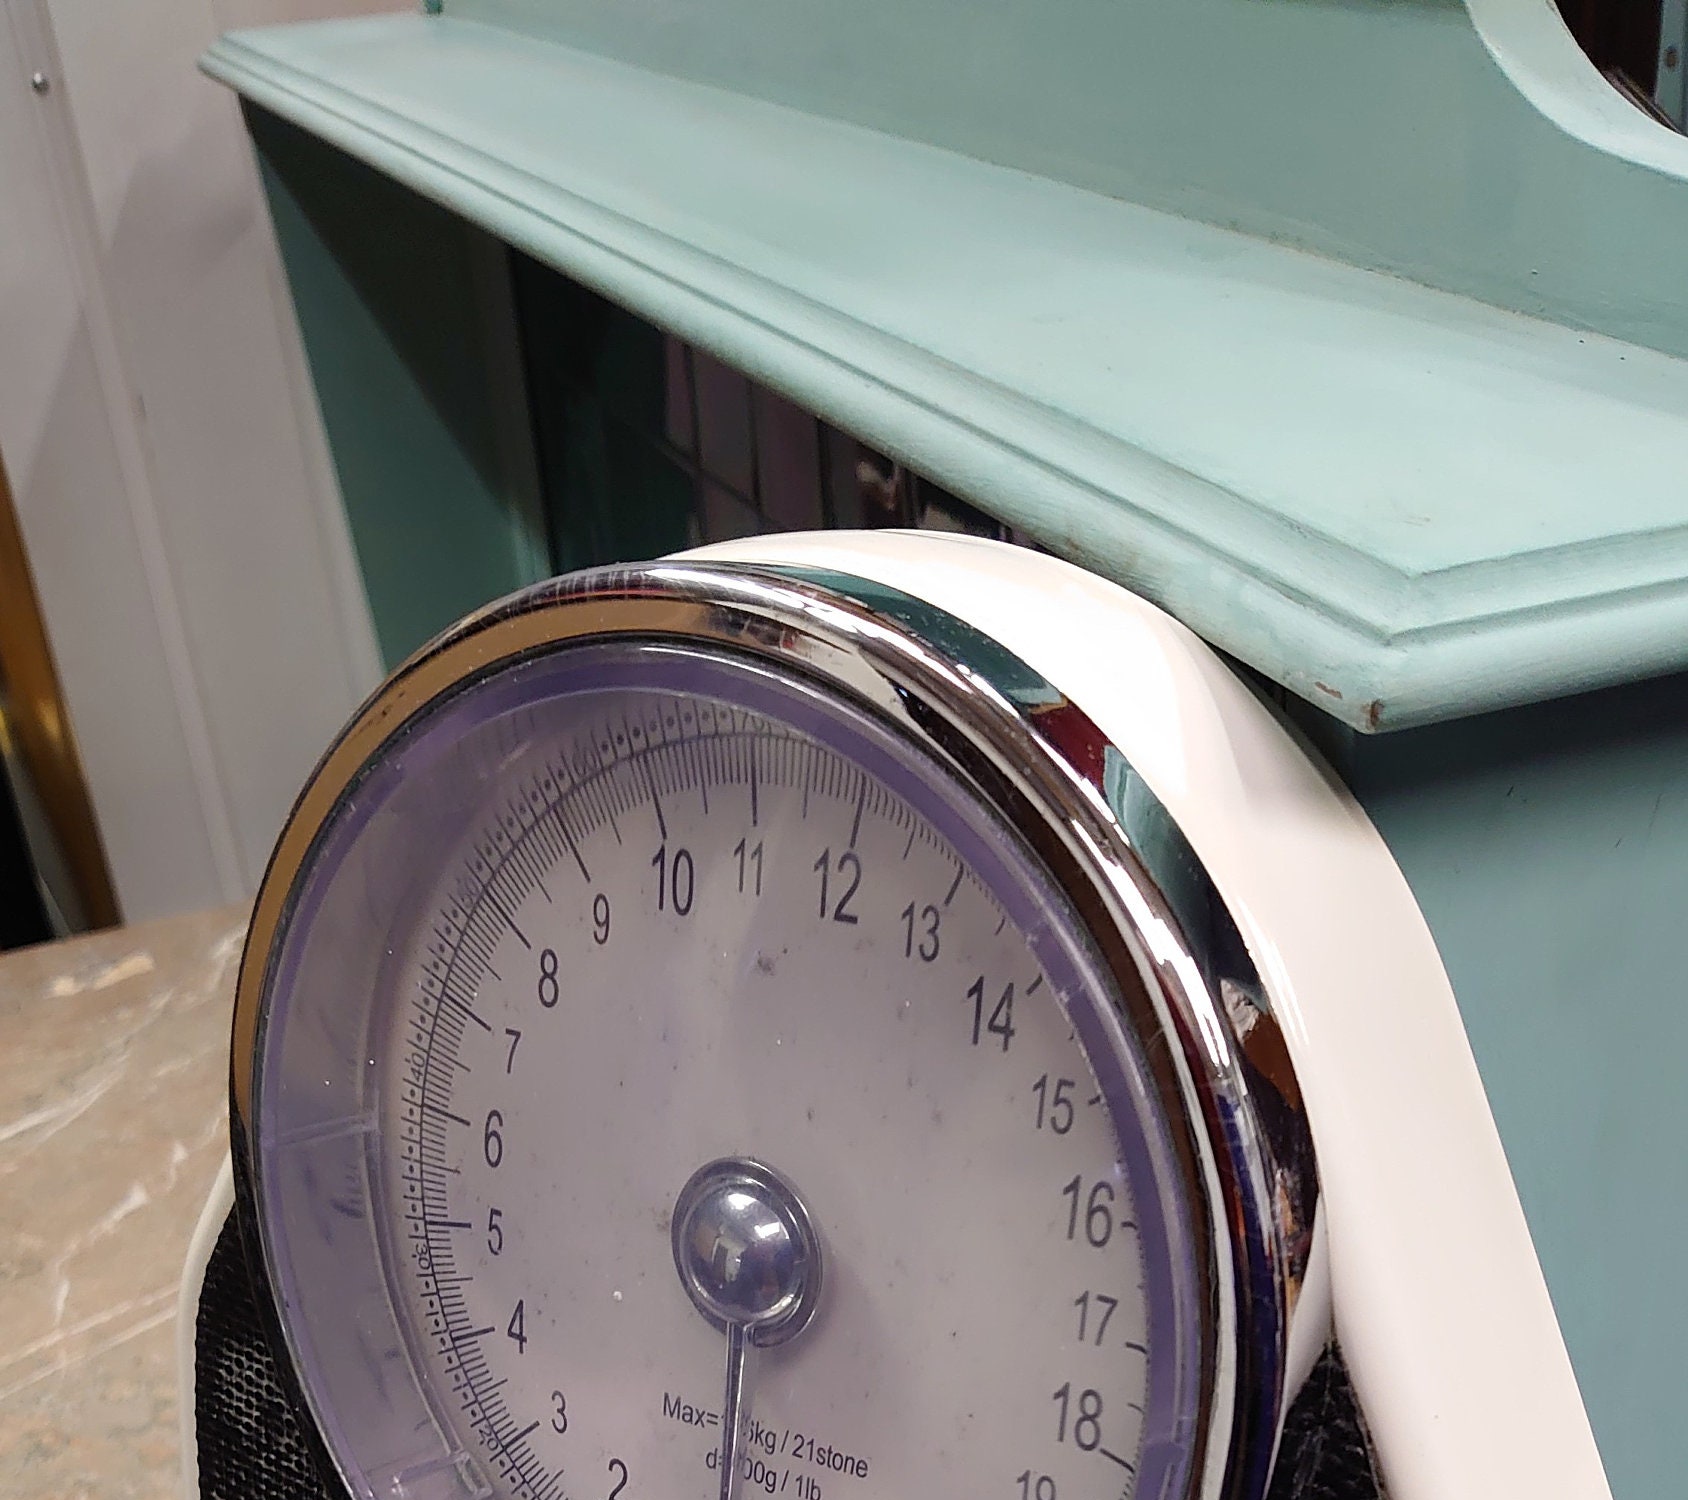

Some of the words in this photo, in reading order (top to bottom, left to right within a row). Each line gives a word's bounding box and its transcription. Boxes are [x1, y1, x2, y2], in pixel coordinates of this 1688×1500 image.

[652, 843, 695, 917] 10
[733, 837, 764, 898] 11
[813, 846, 862, 925] 12
[593, 892, 611, 945] 9
[901, 900, 941, 963] 13
[537, 948, 560, 1008] 8
[966, 975, 1015, 1053] 14
[410, 1052, 425, 1082] 40
[504, 1027, 522, 1075] 7
[1032, 1073, 1076, 1136] 15
[484, 1108, 503, 1168] 6
[487, 1207, 503, 1256] 5
[1061, 1174, 1115, 1248] 16
[415, 1242, 431, 1270] 30
[507, 1298, 528, 1355] 4
[1074, 1290, 1119, 1346] 17
[478, 1427, 499, 1451] 20
[551, 1390, 568, 1434] 3
[663, 1392, 777, 1455] Max=kg
[792, 1433, 869, 1479] 21stone
[1053, 1381, 1103, 1451] 18
